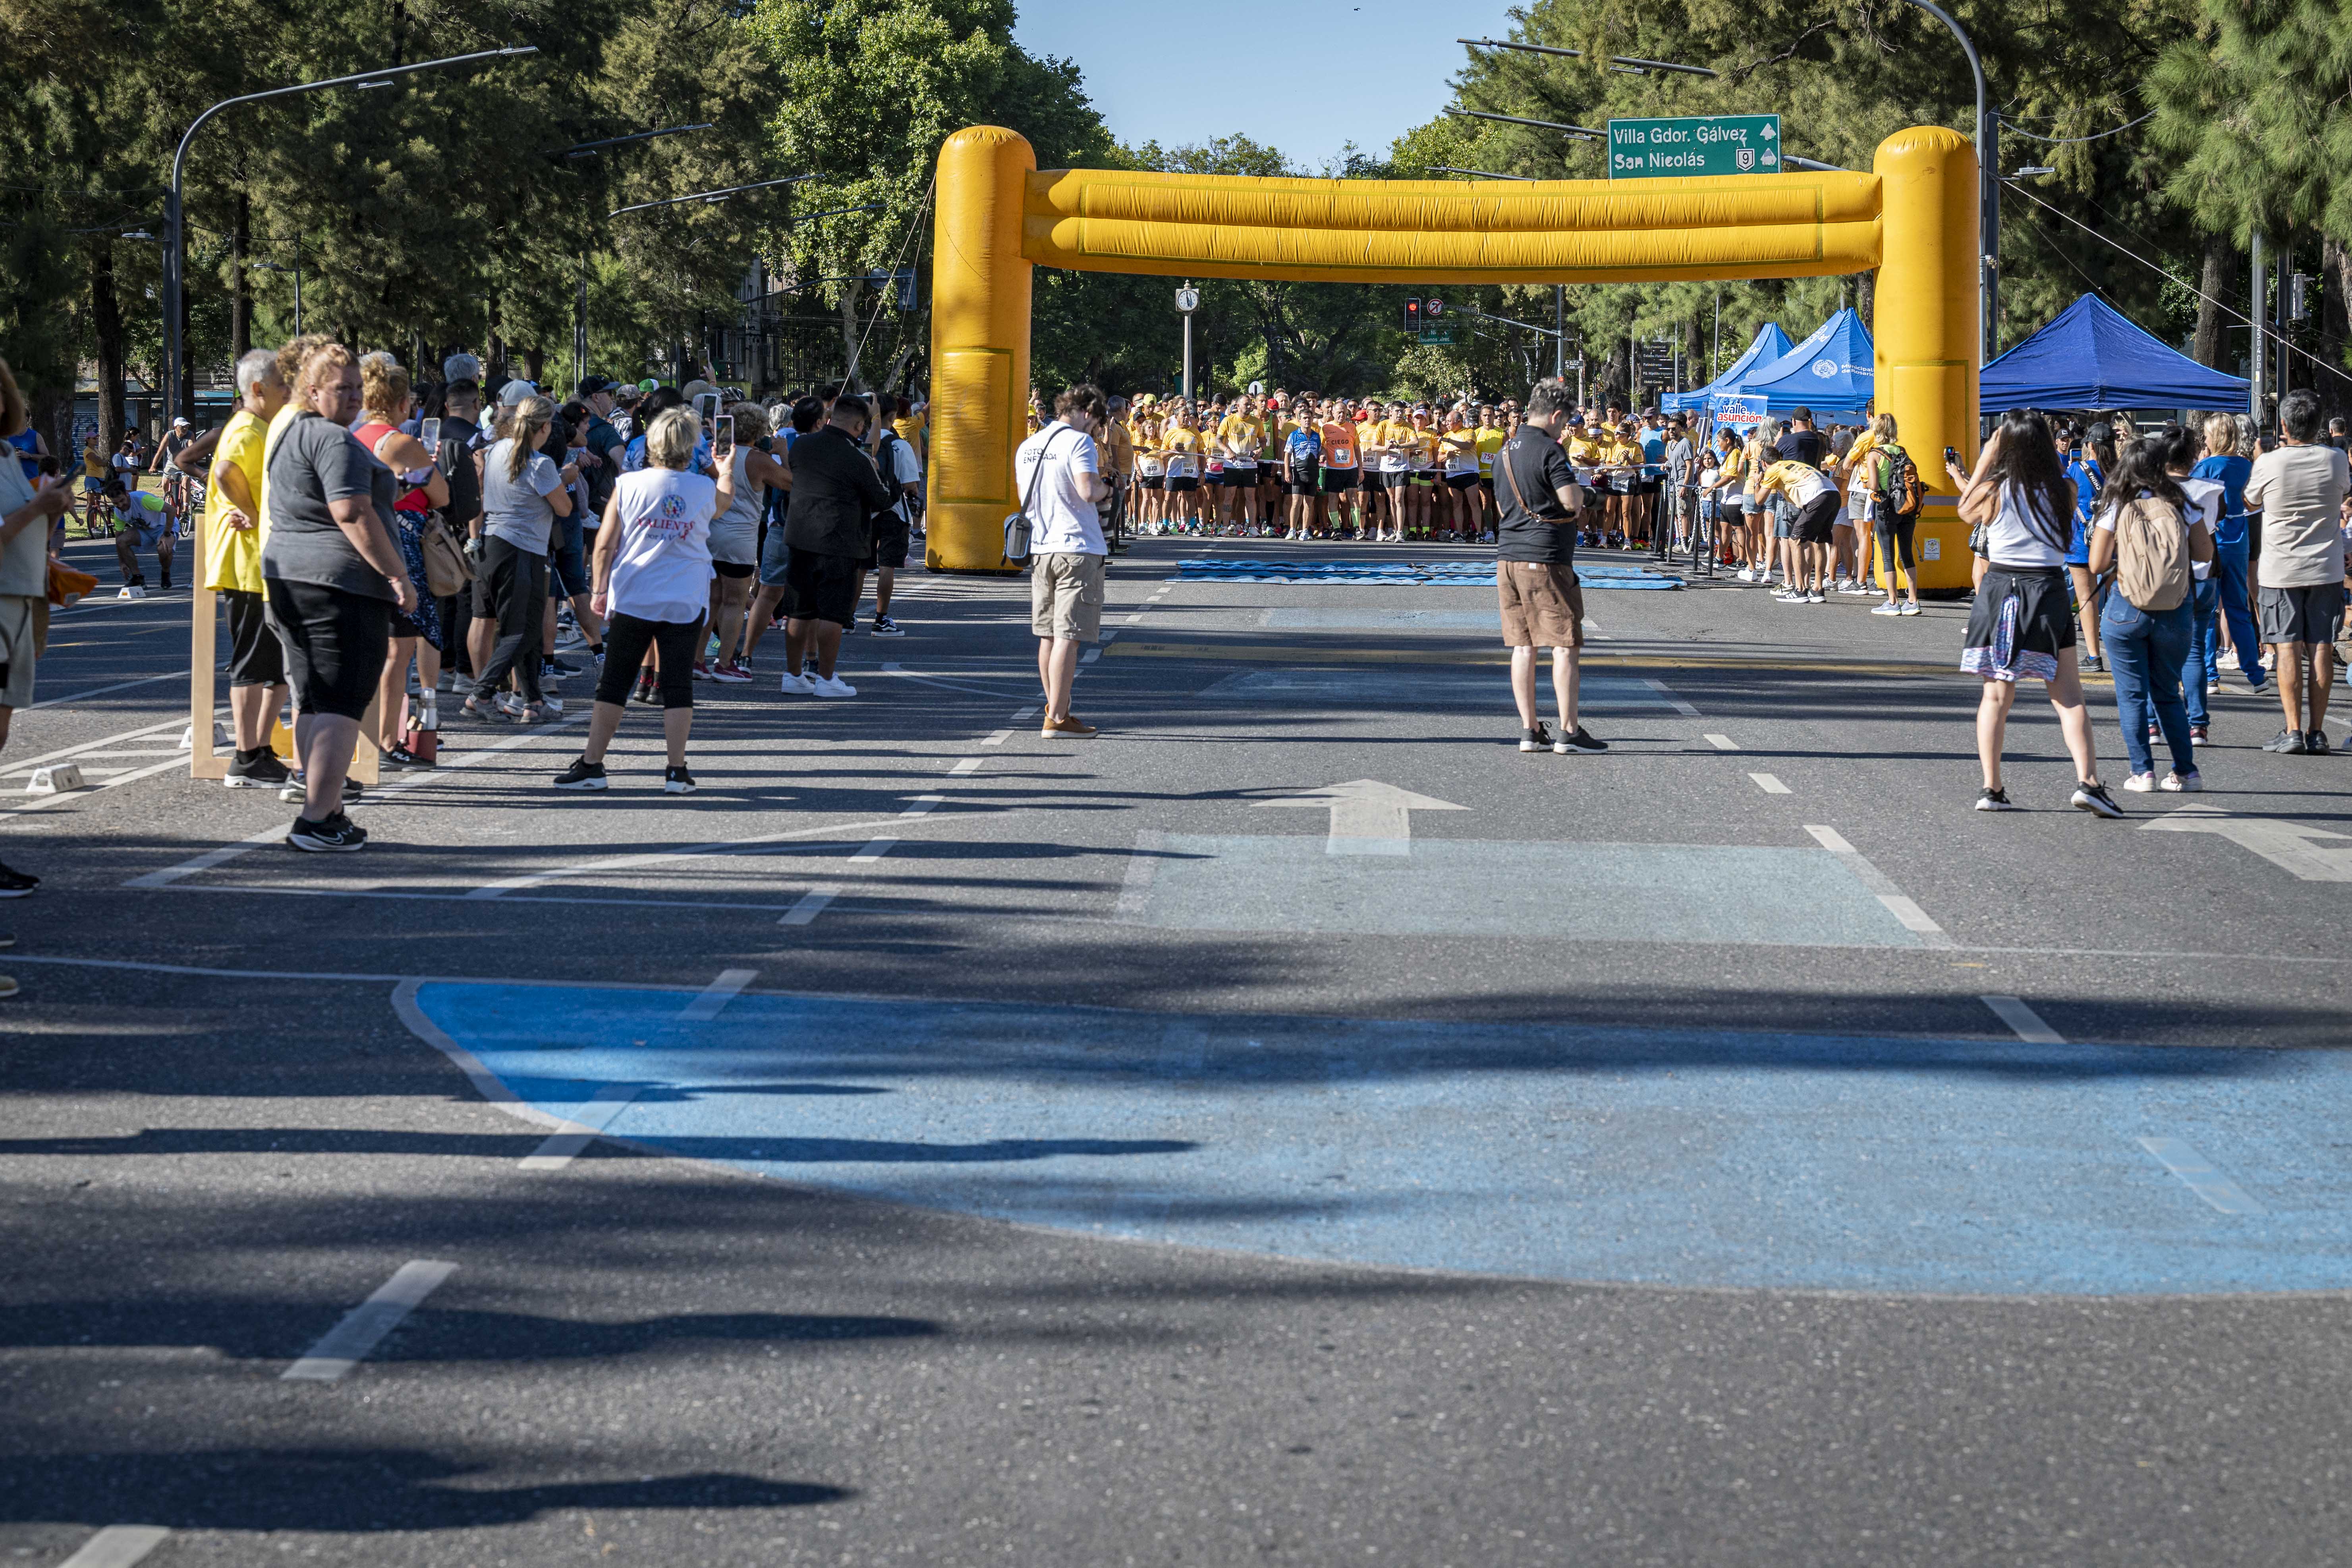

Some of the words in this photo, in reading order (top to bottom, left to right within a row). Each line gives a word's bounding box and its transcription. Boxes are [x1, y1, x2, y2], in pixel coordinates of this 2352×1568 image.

[1614, 128, 1645, 144] Villa
[1651, 127, 1690, 143] Gdor.
[1697, 126, 1747, 141] Gálvez
[1614, 154, 1643, 170] San
[1649, 151, 1705, 168] Nicolás
[1742, 152, 1749, 164] 9
[1723, 404, 1747, 414] valle
[1717, 412, 1762, 423] asunción
[2088, 471, 2101, 490] CHUNA
